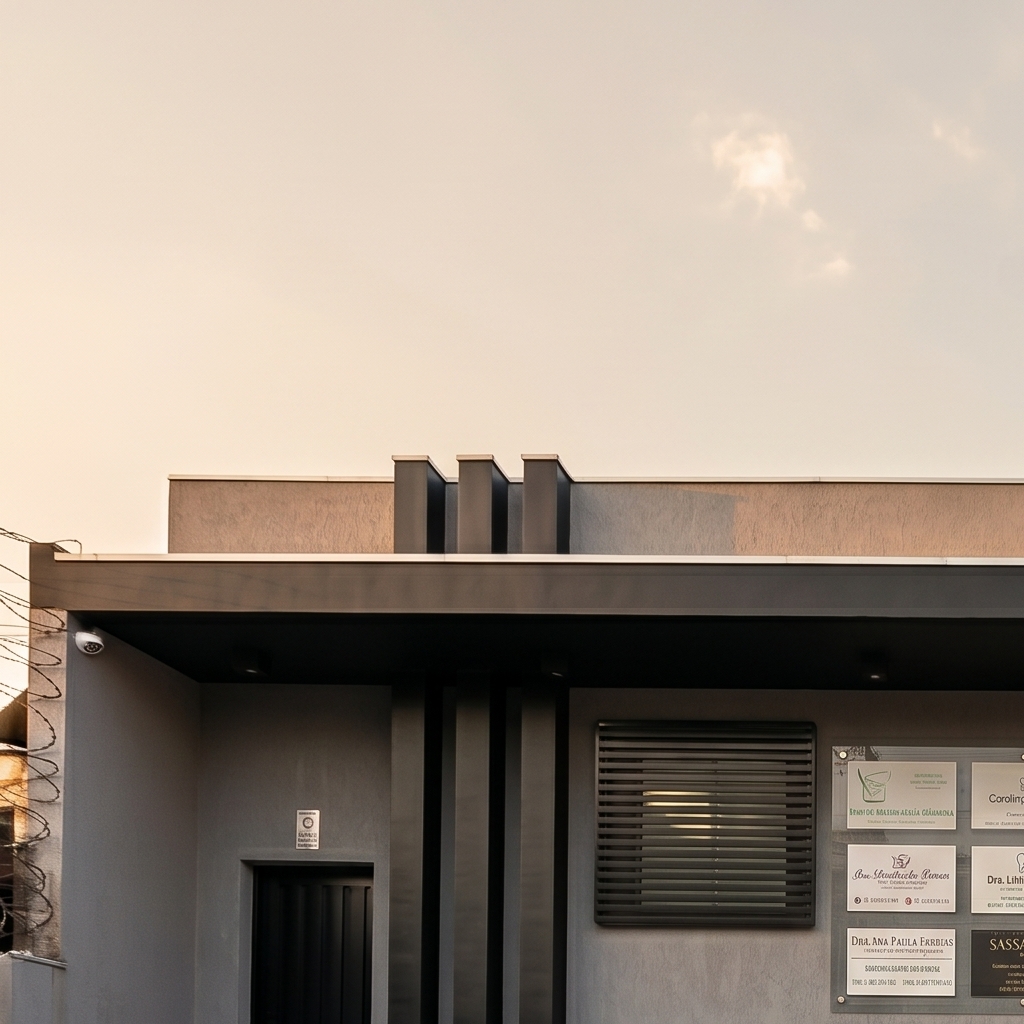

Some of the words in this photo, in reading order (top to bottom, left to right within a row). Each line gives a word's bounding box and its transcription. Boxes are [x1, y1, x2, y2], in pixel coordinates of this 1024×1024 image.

[987, 875, 1005, 885] Dra.
[872, 936, 889, 946] ANA
[891, 936, 918, 947] PAULA
